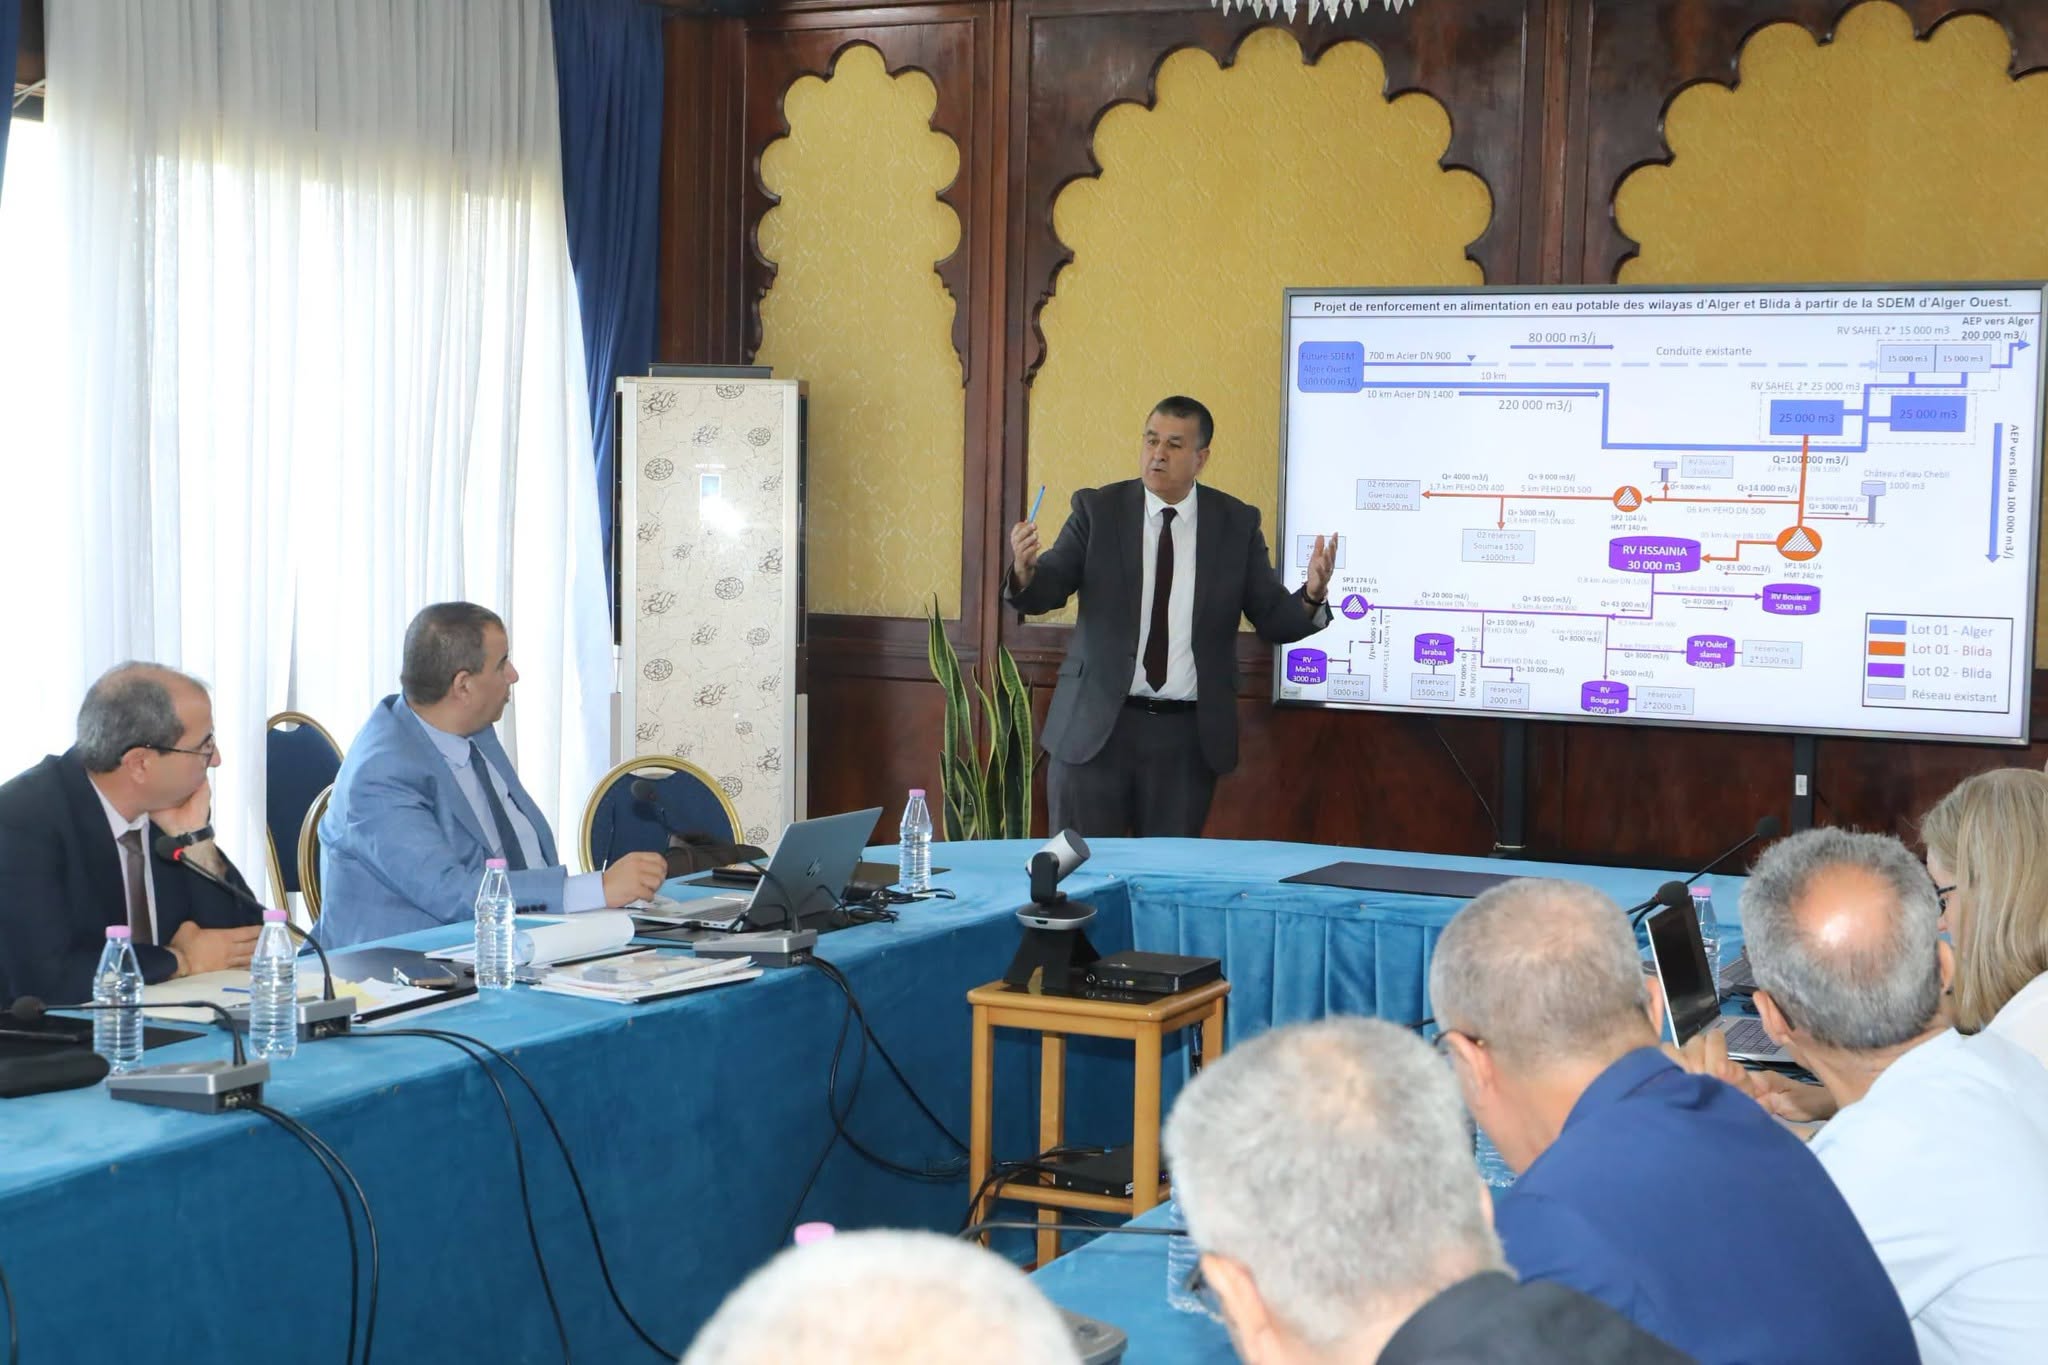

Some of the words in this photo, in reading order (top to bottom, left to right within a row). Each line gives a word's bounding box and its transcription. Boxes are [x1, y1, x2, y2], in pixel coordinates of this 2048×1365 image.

[1314, 302, 1346, 314] Projet
[1350, 302, 1362, 311] de
[1366, 302, 1439, 311] renforcement
[1444, 303, 1456, 311] en
[1460, 301, 1530, 311] alimentation
[1576, 300, 1619, 312] potable
[1623, 300, 1644, 310] des
[1648, 300, 1692, 311] wilayas
[1697, 300, 1739, 311] d'Alger
[1744, 301, 1755, 309] et
[1760, 299, 1790, 308] Blida
[1795, 299, 1801, 308] à
[1806, 300, 1838, 310] partir
[1843, 298, 1857, 308] de
[1862, 298, 1872, 308] la
[1877, 298, 1914, 308] SDEM
[1919, 297, 1965, 310] d'Alger
[1970, 298, 2012, 307] Ouest.
[1962, 317, 1982, 325] AEP
[2008, 317, 2034, 326] Alger
[1837, 326, 1850, 334] RV
[1852, 326, 1881, 335] SAHEL
[1900, 326, 1907, 335] 15
[1910, 326, 1931, 335] 000
[1934, 326, 1949, 334] m3
[1962, 331, 1979, 339] 200
[1982, 331, 2000, 339] 000
[2004, 330, 2027, 340] m3/j
[1529, 333, 1542, 342] 80
[1546, 333, 1566, 342] 000
[1570, 332, 1596, 344] m3/j
[1369, 352, 1383, 360] 700
[1396, 352, 1417, 360] Acier
[1420, 352, 1433, 360] DN
[1436, 352, 1451, 360] 900
[1656, 346, 1702, 356] Conduite
[1705, 346, 1752, 356] existante
[1481, 372, 1491, 380] 10
[1494, 372, 1506, 380] km
[1811, 382, 1822, 390] 25
[1824, 382, 1842, 390] 000
[1846, 382, 1860, 390] m3
[1368, 390, 1377, 398] 10
[1379, 390, 1392, 398] km
[1418, 390, 1430, 398] DN
[1433, 390, 1453, 398] 1400
[1499, 400, 1518, 410] 220
[1522, 400, 1542, 410] 000
[1546, 400, 1572, 412] m3/j
[1779, 414, 1792, 423] 25
[1795, 414, 1814, 423] 000
[1818, 414, 1835, 423] m3
[1900, 409, 1913, 419] 25
[1916, 409, 1936, 419] 000
[1940, 409, 1957, 419] m3
[2011, 424, 2019, 443] AEP
[1826, 456, 1848, 466] m3/j
[2008, 468, 2017, 493] Blida
[2006, 516, 2015, 533] 000
[1622, 546, 1636, 554] RV
[1640, 546, 1687, 556] HSSAINIA
[1628, 561, 1640, 570] 30
[1643, 562, 1662, 570] 000
[1665, 562, 1681, 570] m3
[1911, 624, 1930, 635] Lot
[1935, 625, 1948, 635] 01
[1961, 626, 1994, 638] Alger
[1912, 644, 1930, 654] Lot
[1935, 645, 1949, 655] 01
[1962, 645, 1992, 657] Blida
[1912, 666, 1930, 676] Lot
[1935, 667, 1949, 677] 02
[1962, 667, 1992, 679] Blida
[1912, 689, 1951, 700] Réseau
[1954, 691, 1997, 703] existant
